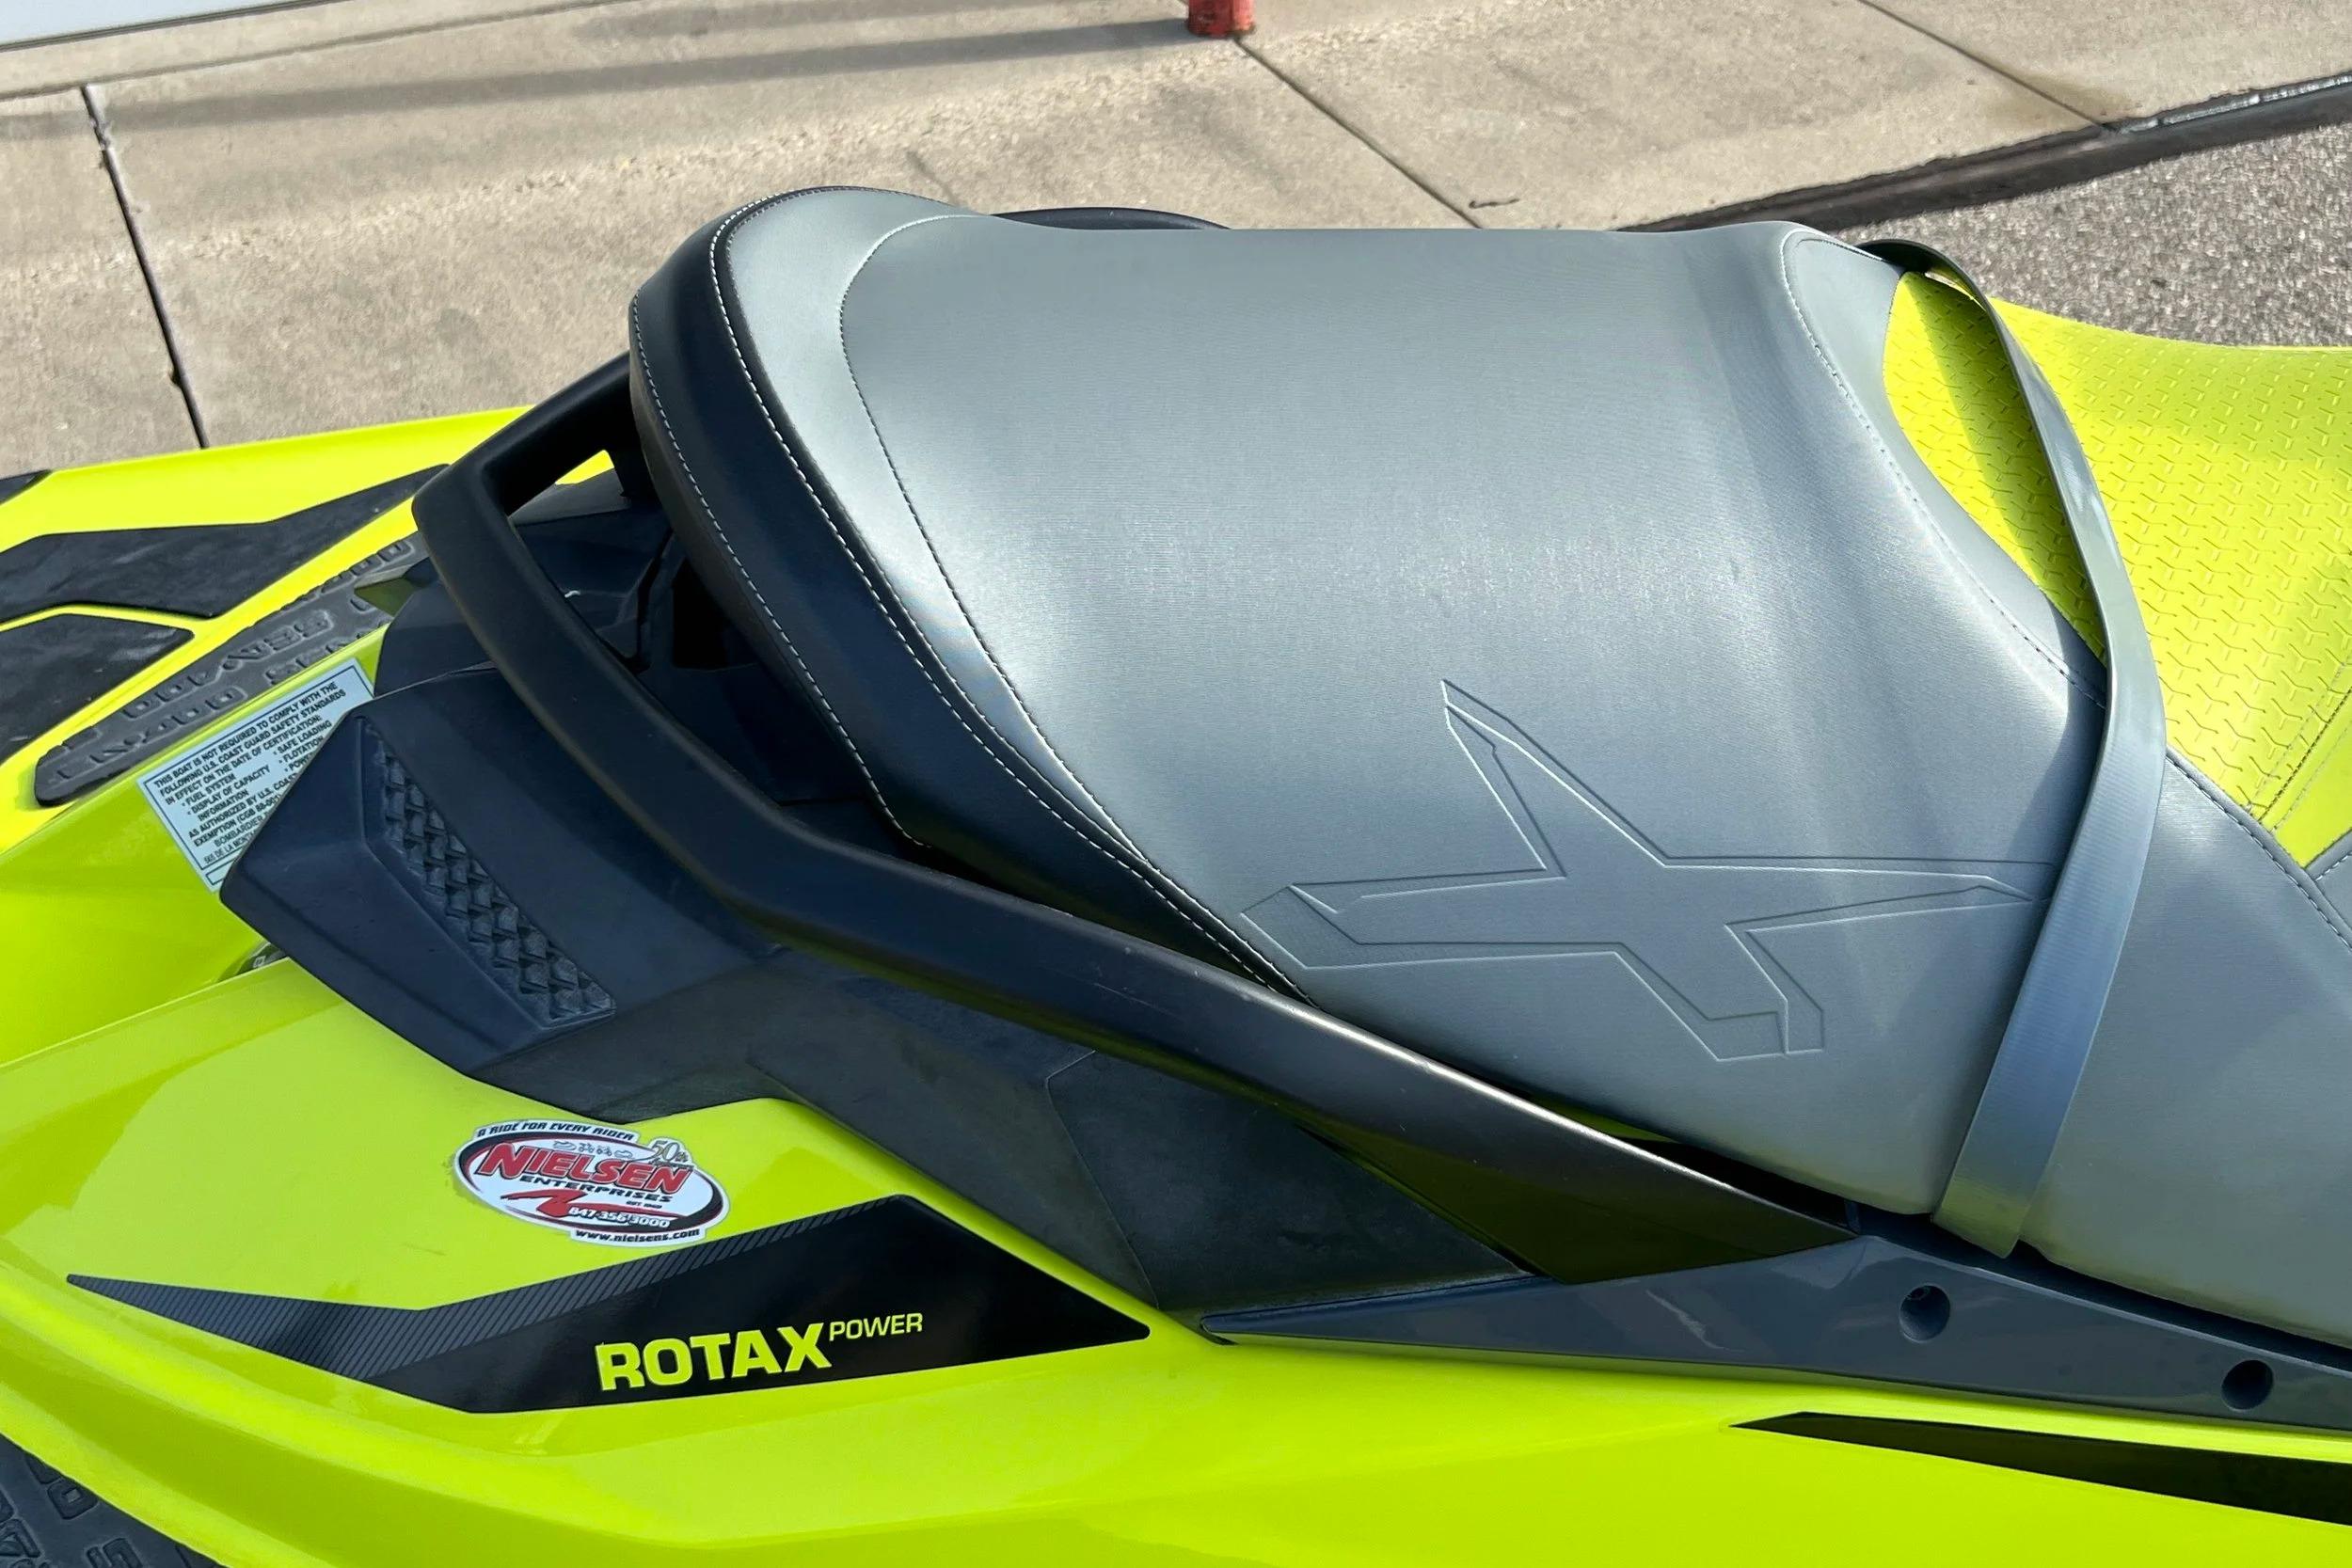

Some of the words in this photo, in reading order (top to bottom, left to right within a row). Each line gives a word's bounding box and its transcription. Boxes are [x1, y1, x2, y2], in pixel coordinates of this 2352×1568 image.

[154, 774, 172, 787] THIS
[172, 762, 193, 777] BOAT
[193, 757, 201, 766] IS
[201, 748, 217, 761] NOT
[217, 726, 257, 752] REQUIRED
[257, 720, 268, 730] TO
[268, 703, 299, 723] COMPLY
[299, 691, 320, 706] WITH
[321, 682, 337, 694] THE
[160, 768, 202, 796] FOLLOWING
[217, 745, 243, 763] COAST
[244, 730, 270, 749] GUARD
[271, 714, 300, 734] SAFETY
[300, 689, 345, 717] STANDARDS
[278, 738, 297, 753] SAFE
[297, 720, 331, 742] LOADING
[166, 796, 174, 804] IN
[175, 780, 202, 799] EFFECT
[202, 773, 215, 783] ON
[215, 764, 230, 776] THE
[230, 752, 250, 767] DATE
[251, 746, 262, 755] OF
[262, 714, 321, 750] CERTIFICATION:
[185, 790, 205, 804] FUEL
[205, 773, 235, 793] SYSTEM
[191, 792, 222, 813] DISPLAY
[222, 785, 233, 795] OF
[233, 765, 270, 789] CAPACITY
[198, 789, 247, 820] INFORMATION
[188, 829, 199, 837] AS
[199, 801, 246, 832] AUTHORIZED
[246, 796, 258, 804] BY
[193, 818, 236, 846] EXEMPTION
[488, 1124, 517, 1134] RIDE
[549, 1122, 591, 1133] EVERY
[593, 1126, 635, 1141] RIDER
[474, 1143, 693, 1194] NIELSEN
[520, 1176, 674, 1202] ENTERPRISES
[576, 1228, 700, 1243] www.nielsens.com
[595, 1323, 832, 1390] ROTAX
[829, 1312, 923, 1341] POWER
